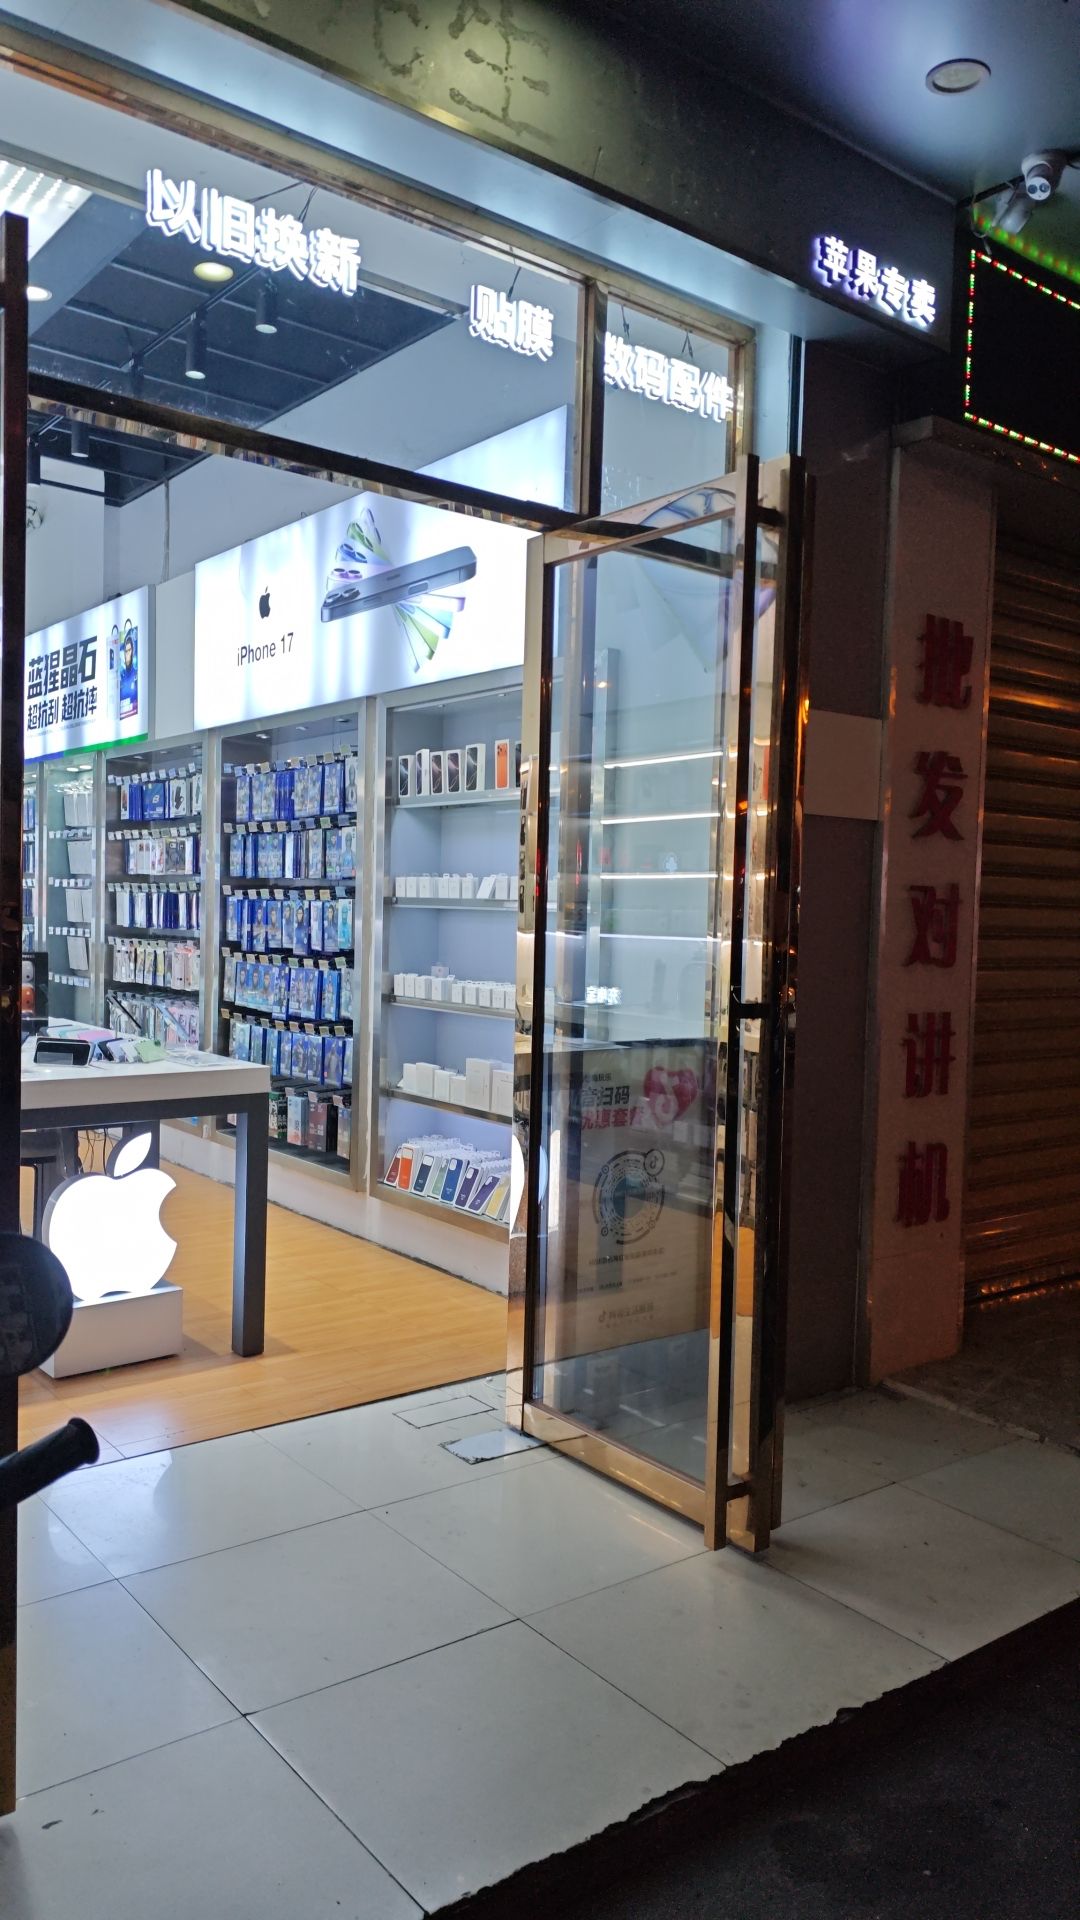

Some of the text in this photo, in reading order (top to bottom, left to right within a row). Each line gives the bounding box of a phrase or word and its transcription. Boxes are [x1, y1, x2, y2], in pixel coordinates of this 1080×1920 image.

[145, 168, 362, 297] 以旧换新
[815, 235, 937, 327] 苹果专卖
[468, 282, 554, 363] 贴膜
[603, 331, 735, 423] 数码配件
[27, 635, 98, 700] 蓝猩晶石
[237, 632, 294, 667] iPhone 17
[27, 685, 98, 731] 超抗刮 超抗摔
[893, 612, 974, 1229] 批发对讲机
[582, 1085, 631, 1107] 音扫码
